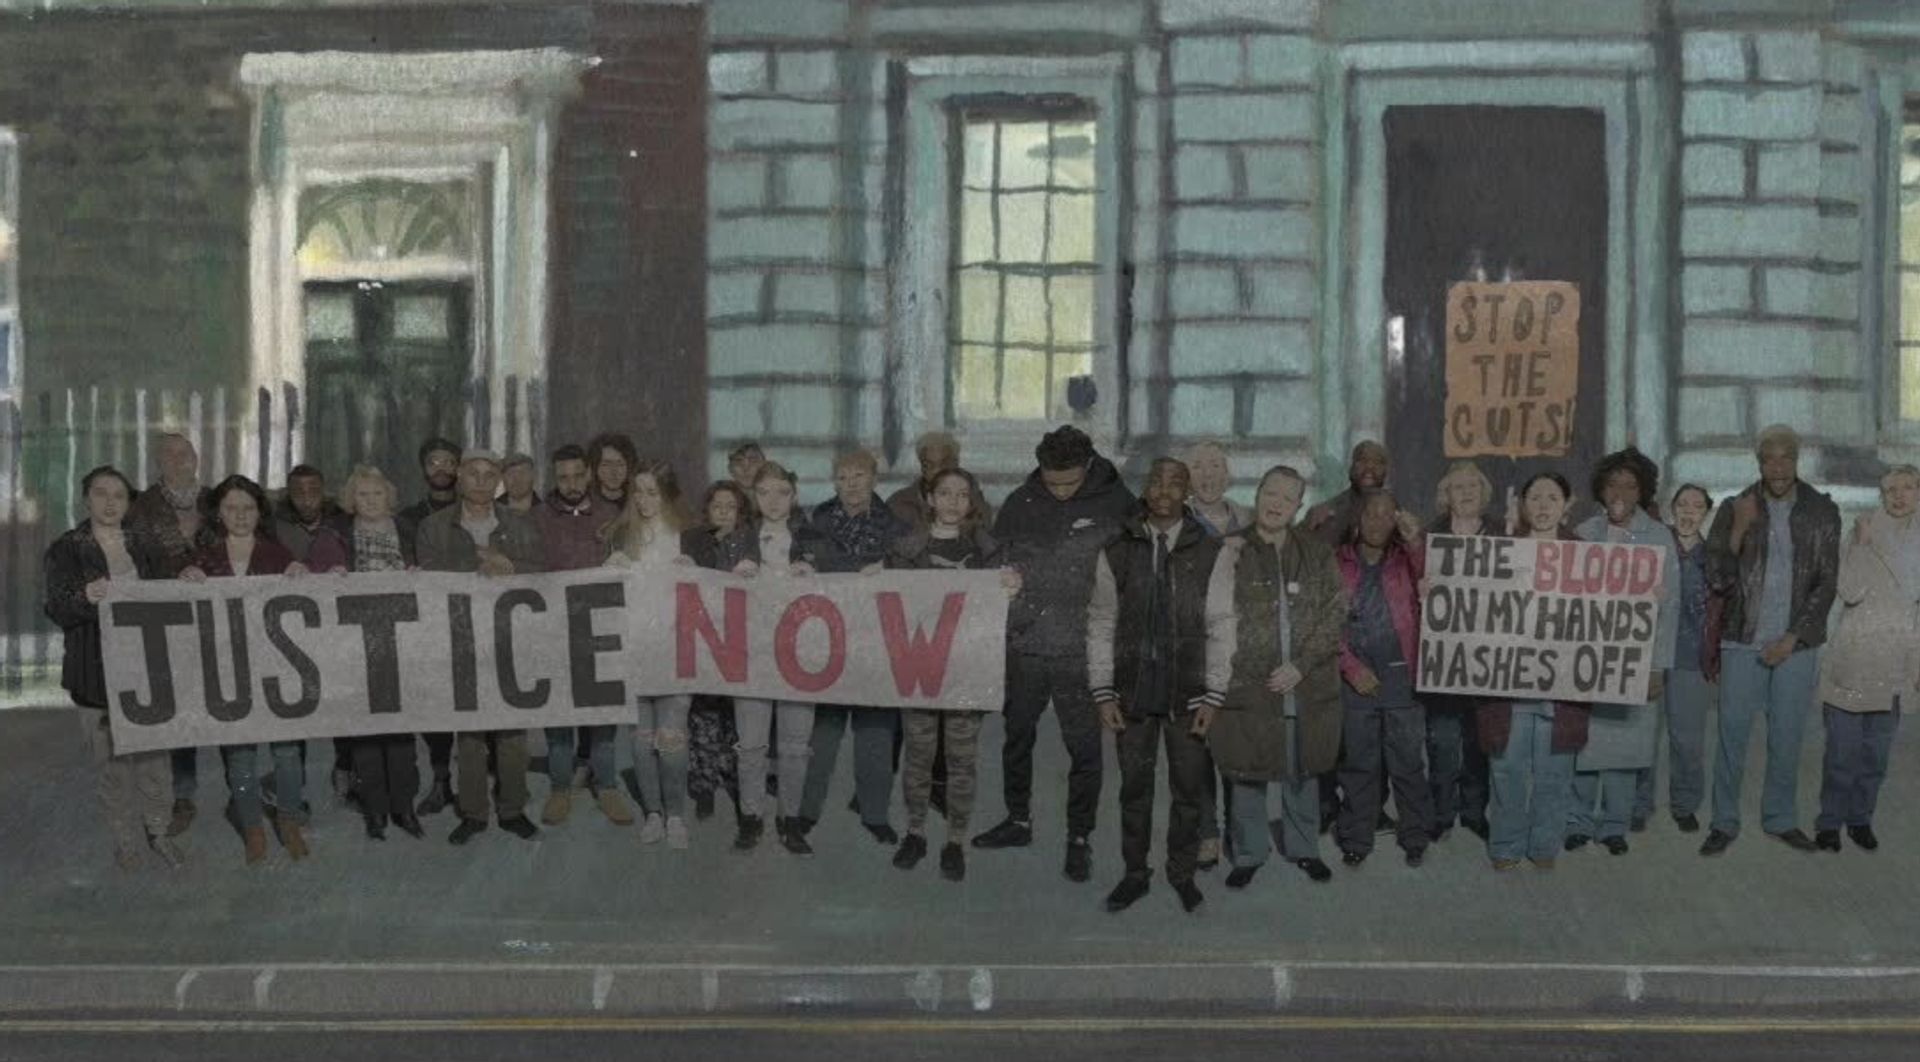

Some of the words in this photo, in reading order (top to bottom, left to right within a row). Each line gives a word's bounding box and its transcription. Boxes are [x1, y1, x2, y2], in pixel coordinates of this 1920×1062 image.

[1454, 287, 1564, 344] STOP
[1472, 352, 1551, 397] THE
[1431, 537, 1514, 579] THE
[1533, 542, 1658, 595] BLOOD
[1426, 585, 1478, 633] ON
[1485, 590, 1534, 635] MY
[1534, 597, 1652, 641] HANDS
[112, 582, 626, 725] JUSTICE
[675, 582, 967, 698] NOW
[1421, 640, 1558, 691] WASHES
[1573, 645, 1642, 695] OFF
